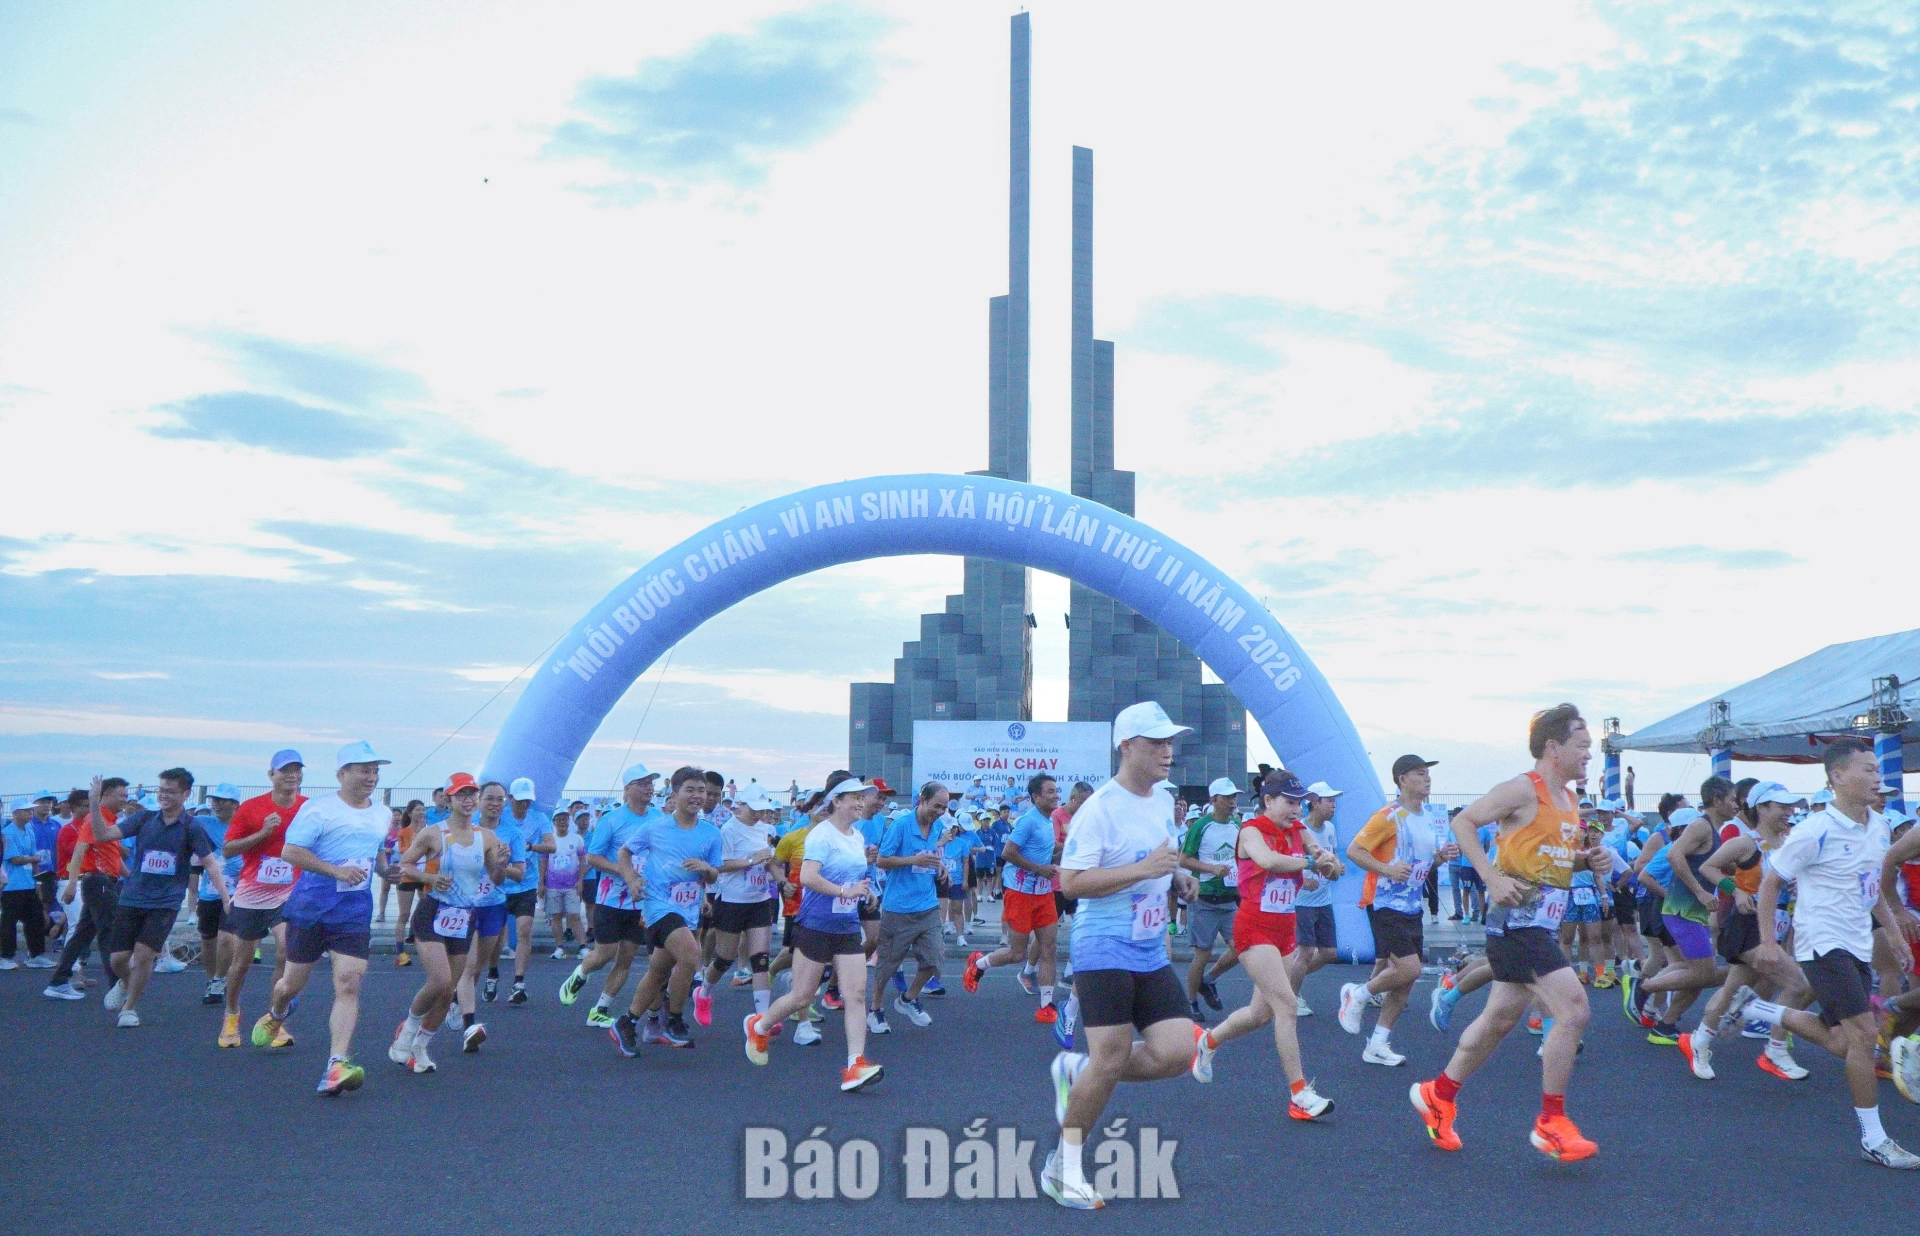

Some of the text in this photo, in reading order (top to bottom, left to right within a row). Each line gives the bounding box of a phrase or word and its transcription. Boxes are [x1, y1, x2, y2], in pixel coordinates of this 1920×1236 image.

[612, 568, 686, 636] BƯỚC
[683, 524, 767, 583] CHÂN
[779, 501, 809, 538] VÌ
[815, 496, 855, 530] AN
[860, 488, 928, 522] SINH
[936, 485, 977, 519] XÃ
[1039, 503, 1100, 547] LẦN
[1100, 524, 1163, 570] THỨ
[1155, 554, 1184, 587] II
[1176, 572, 1247, 634] NĂM
[1237, 625, 1302, 692] 2026
[974, 754, 1008, 770] GIẢI
[148, 858, 170, 869] 008
[264, 865, 288, 878] 057
[675, 889, 698, 903] 034
[1270, 889, 1293, 904] 041
[441, 915, 464, 930] 022
